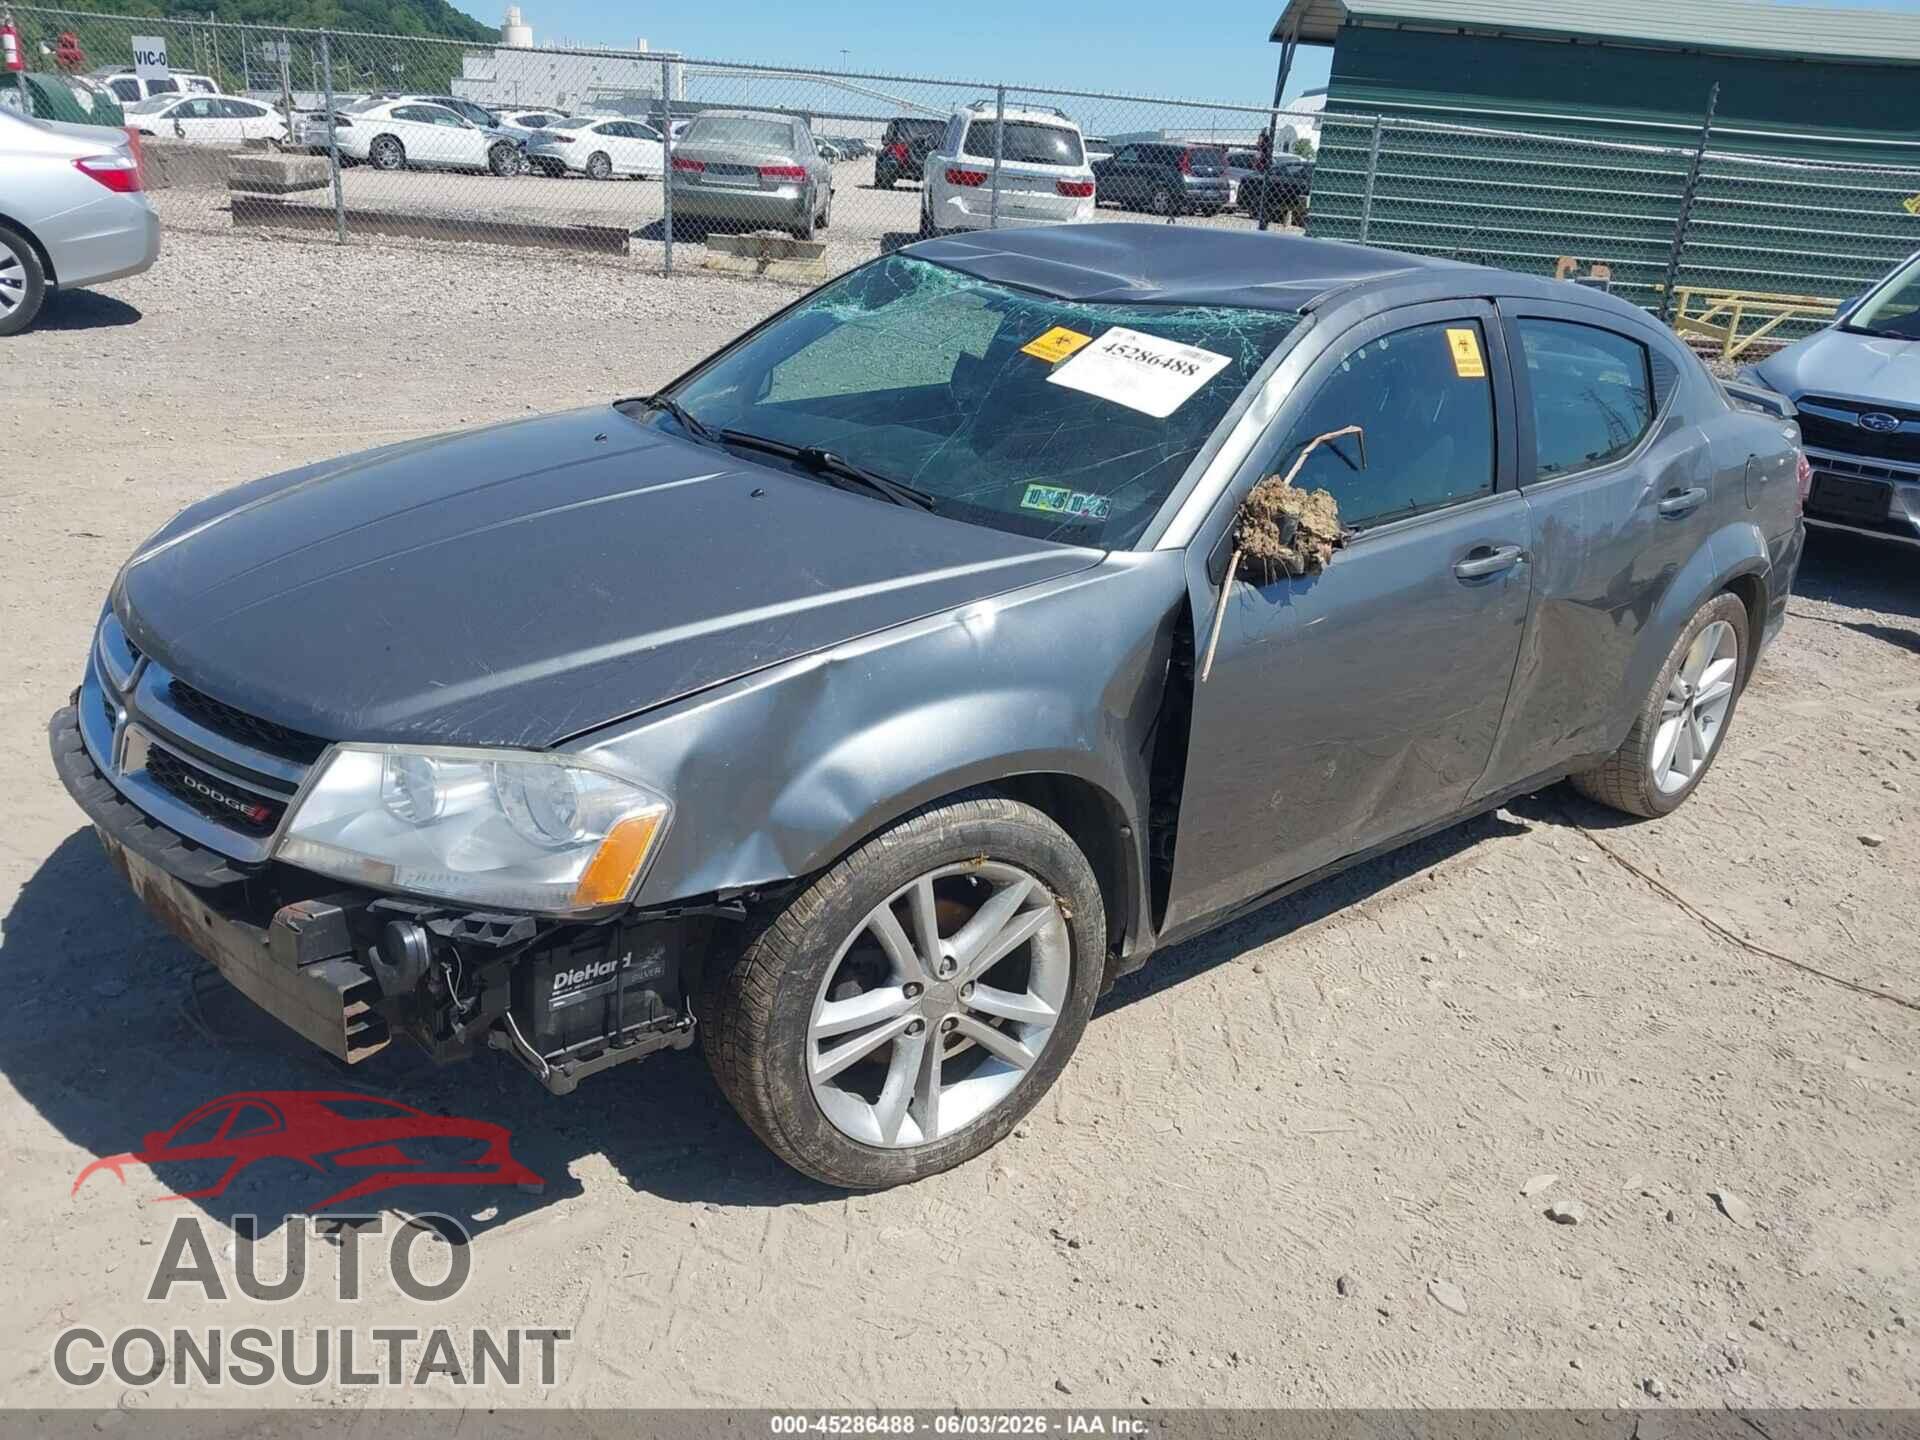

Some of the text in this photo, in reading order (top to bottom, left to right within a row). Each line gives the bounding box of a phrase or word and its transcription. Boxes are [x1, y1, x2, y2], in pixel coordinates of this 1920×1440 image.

[1102, 342, 1201, 377] 45286488
[184, 775, 256, 817] DODGE
[552, 951, 632, 991] DieHard
